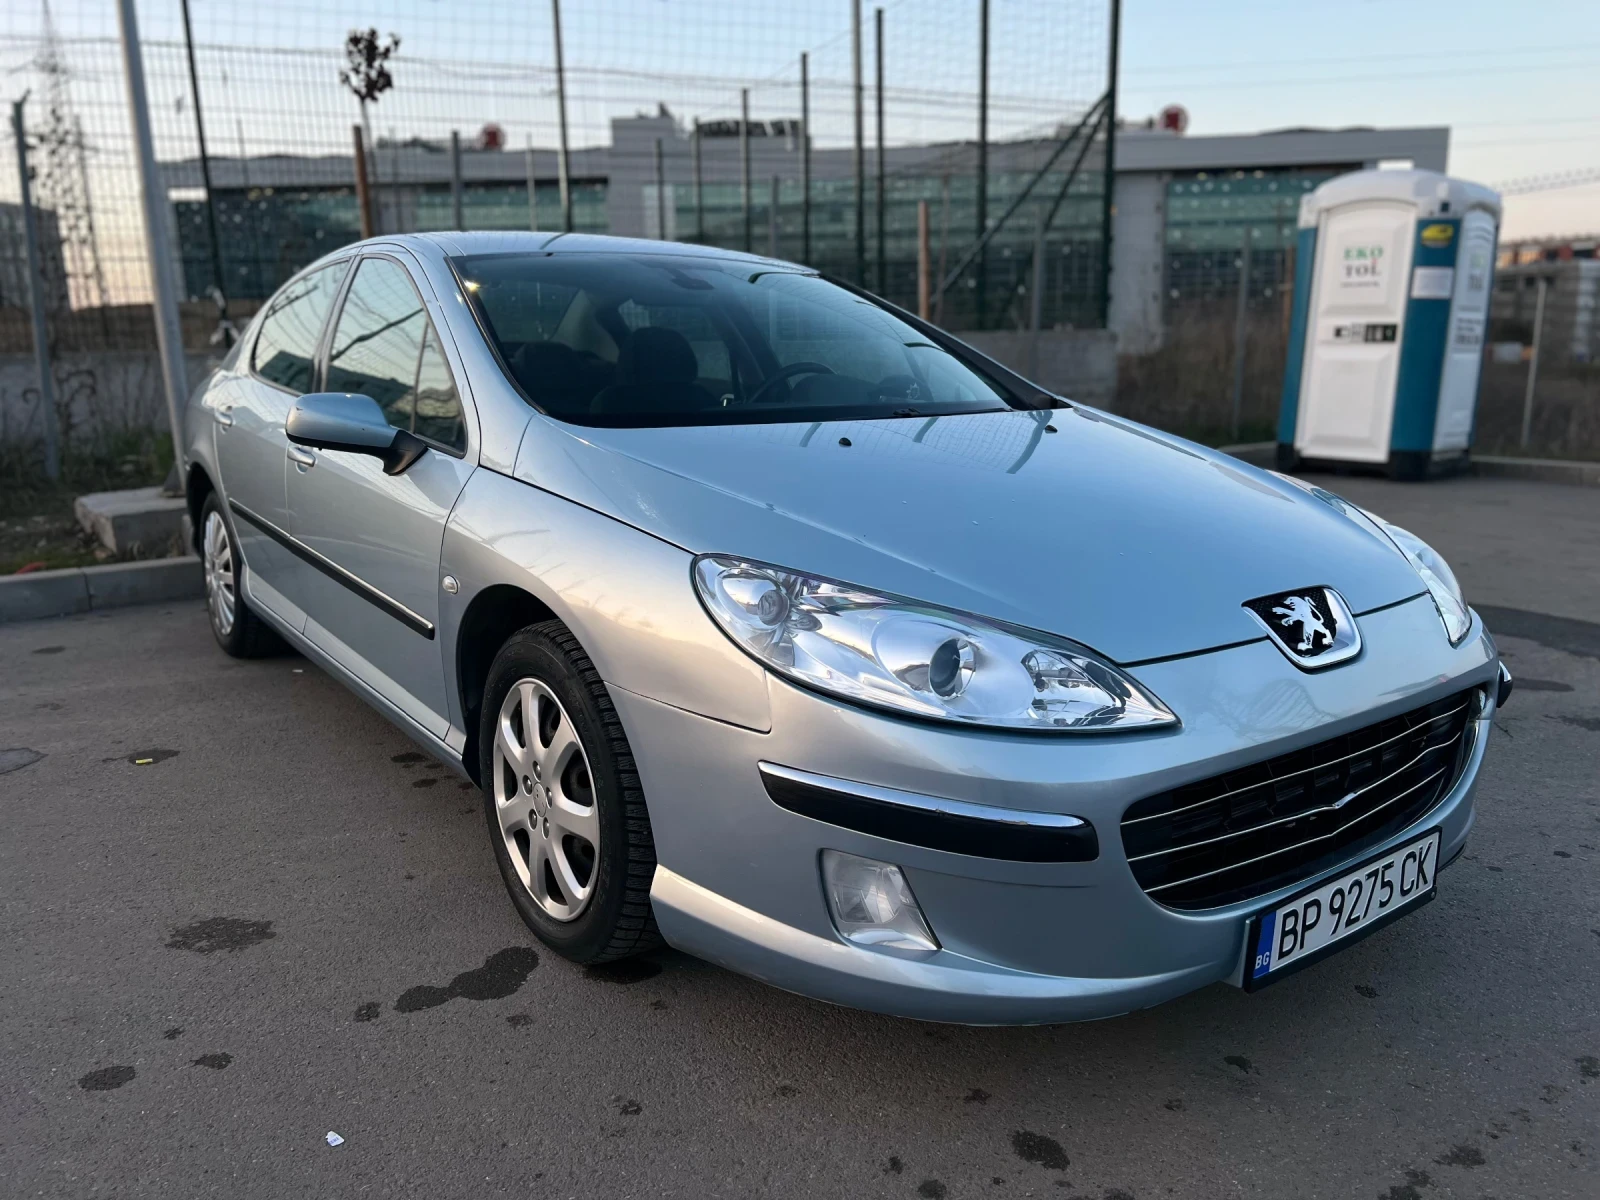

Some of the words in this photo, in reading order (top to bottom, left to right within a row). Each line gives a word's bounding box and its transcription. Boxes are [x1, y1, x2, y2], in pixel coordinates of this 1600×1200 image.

[1343, 246, 1384, 261] EKO
[1278, 898, 1322, 960] BP
[1329, 861, 1395, 936] 9275
[1400, 840, 1433, 897] CK
[1255, 951, 1270, 970] BG
